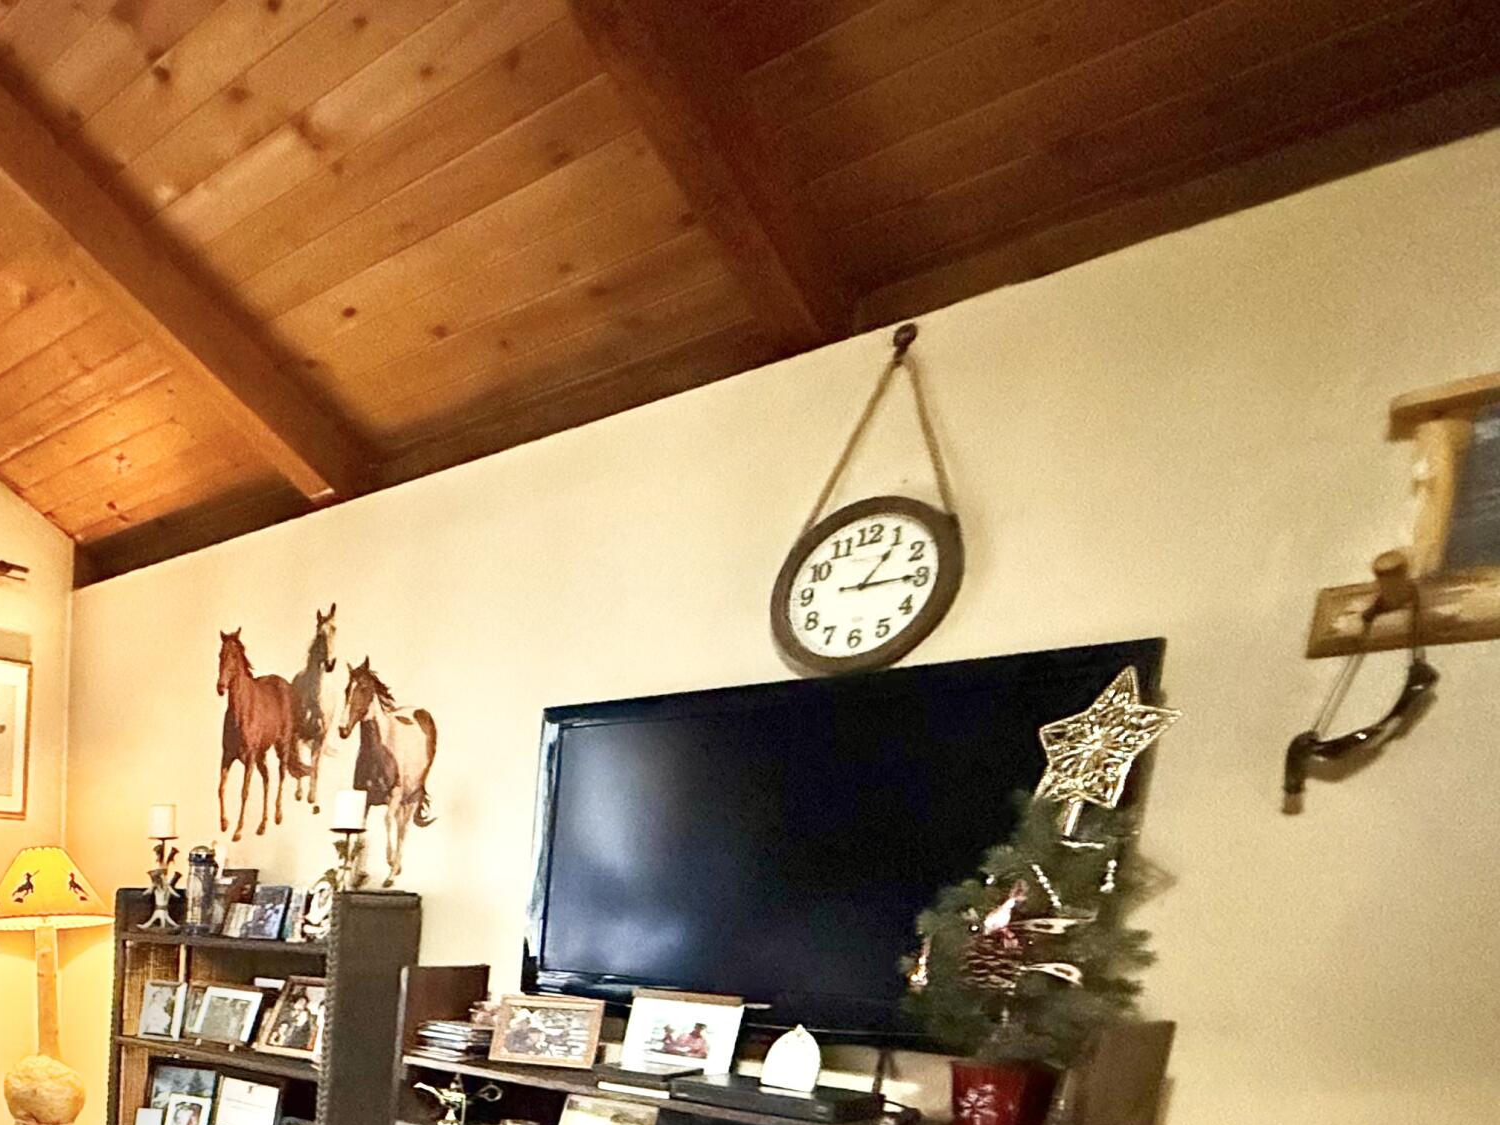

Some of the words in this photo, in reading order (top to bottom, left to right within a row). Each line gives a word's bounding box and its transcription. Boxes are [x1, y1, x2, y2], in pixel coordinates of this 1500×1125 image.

[856, 523, 884, 547] 12
[891, 526, 902, 546] 1
[831, 537, 854, 560] 11
[908, 541, 925, 562] 2
[810, 561, 832, 583] 10
[912, 566, 930, 587] 3
[800, 588, 814, 607] 9
[898, 594, 913, 615] 4
[805, 611, 819, 631] 8
[876, 618, 892, 639] 5
[823, 626, 836, 645] 7
[847, 629, 861, 648] 6
